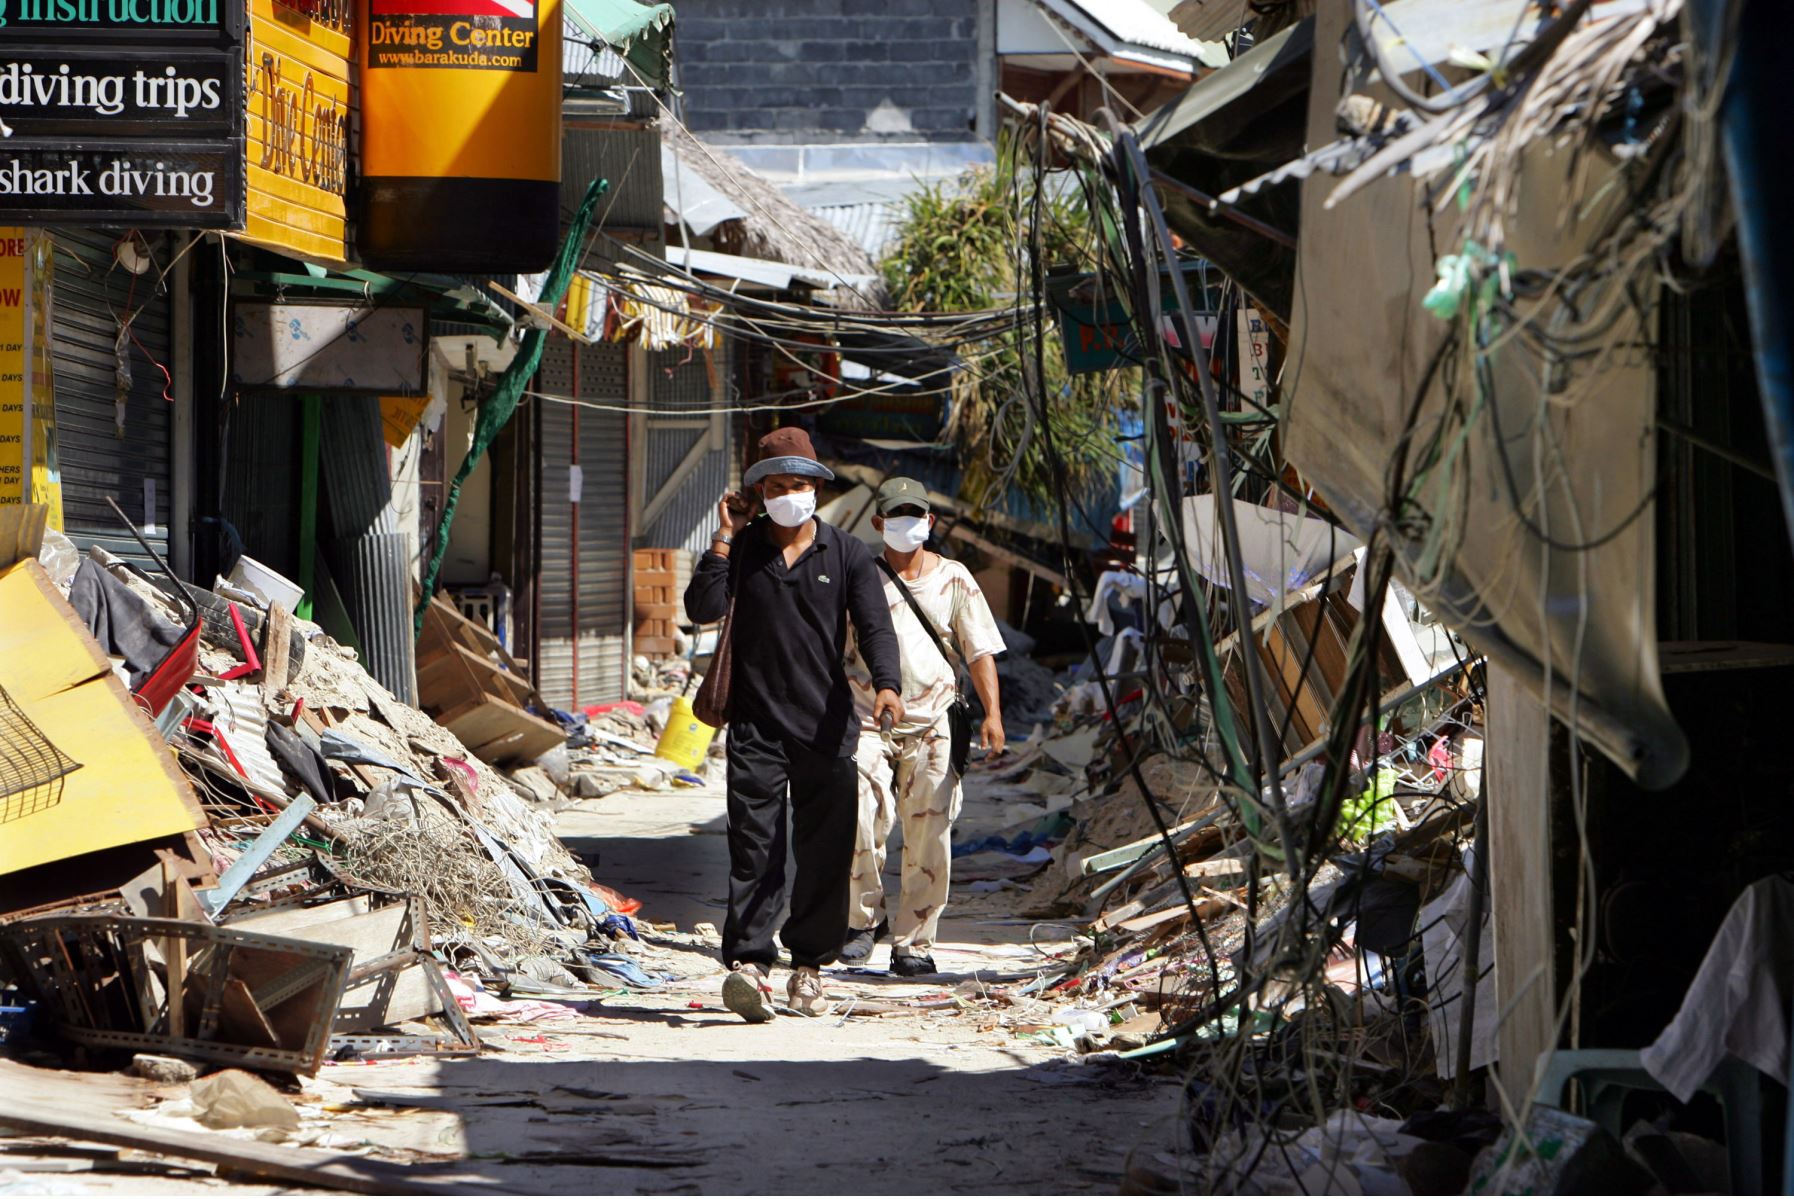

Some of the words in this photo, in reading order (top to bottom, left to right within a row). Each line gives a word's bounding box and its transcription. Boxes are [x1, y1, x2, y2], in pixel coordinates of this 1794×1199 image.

[371, 20, 443, 49] Diving
[450, 21, 534, 49] Center
[378, 50, 522, 68] www.barakuda.com
[0, 63, 125, 115] diving
[132, 66, 221, 117] trips
[261, 52, 297, 178] Dive
[0, 159, 94, 195] shark
[99, 161, 215, 206] diving
